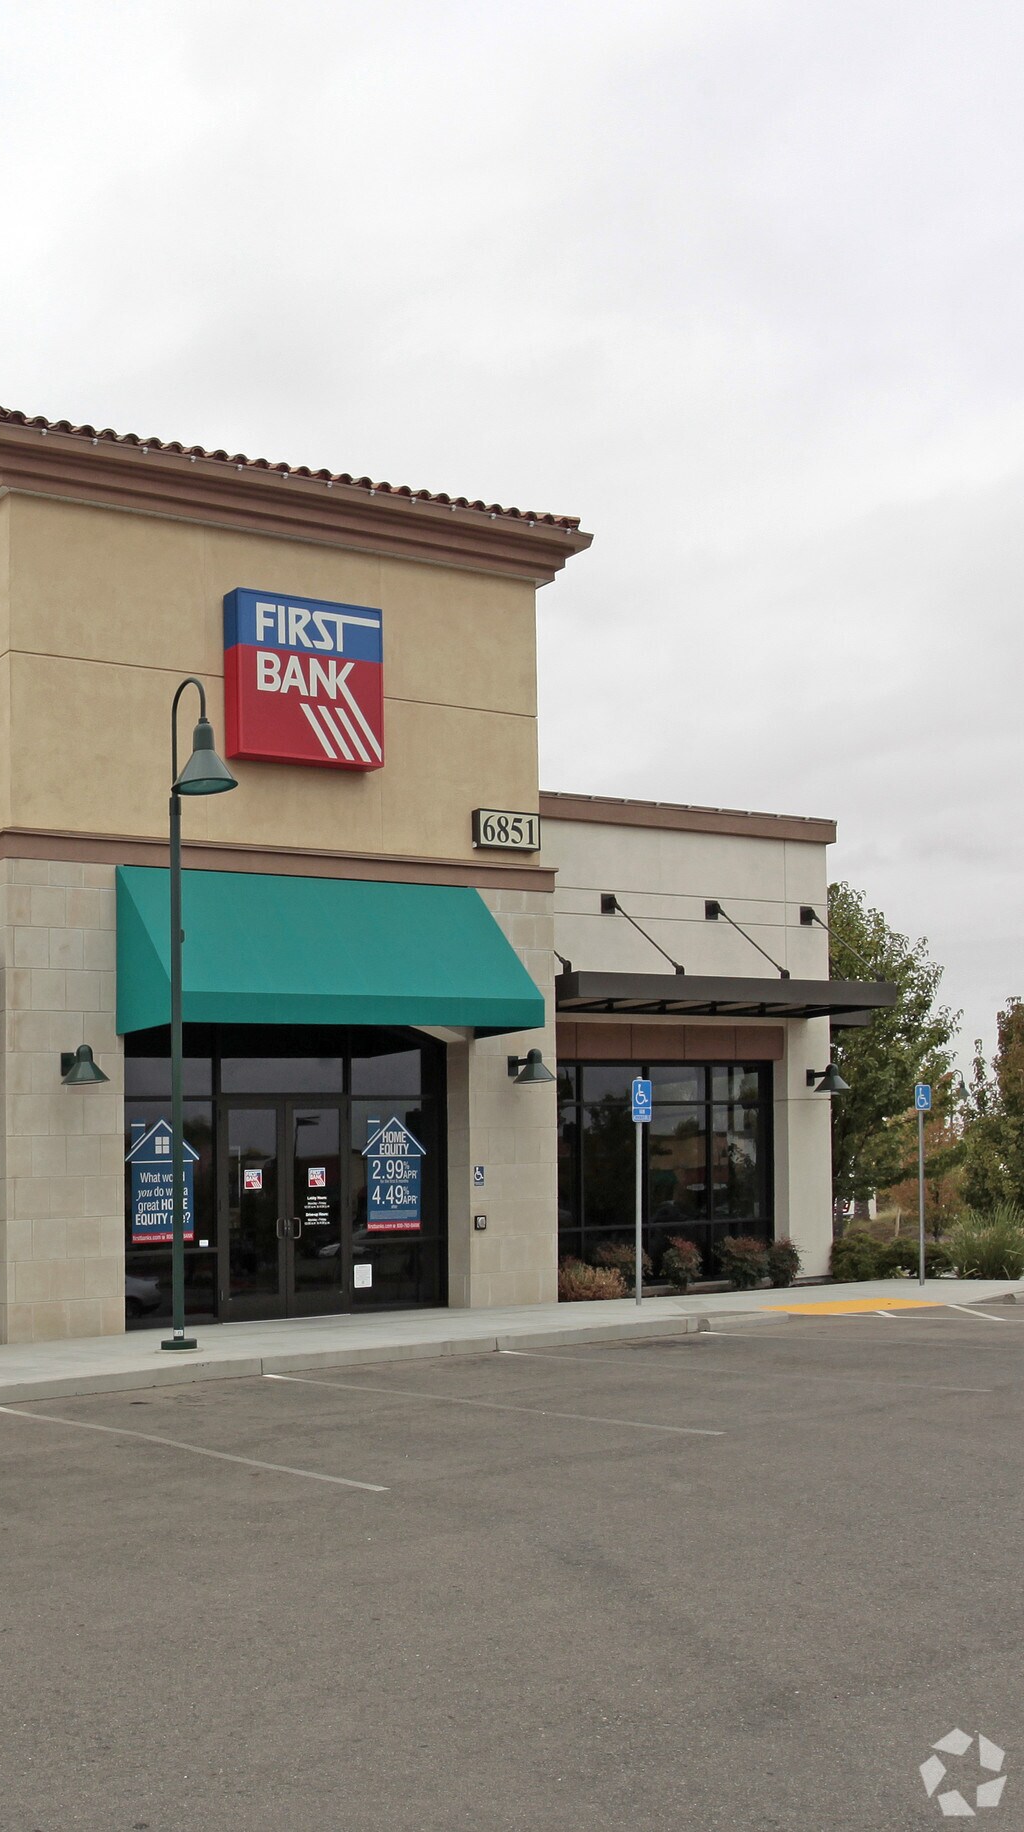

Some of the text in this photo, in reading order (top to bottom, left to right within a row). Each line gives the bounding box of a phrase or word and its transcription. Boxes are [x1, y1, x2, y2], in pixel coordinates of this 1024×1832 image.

[256, 602, 380, 652] FIRST
[483, 814, 536, 846] 6851
[382, 1131, 407, 1143] HOME
[379, 1143, 410, 1155] EQUITY
[140, 1172, 161, 1183] What
[136, 1189, 153, 1201] you
[154, 1186, 164, 1197] do
[183, 1187, 188, 1196] a
[138, 1198, 188, 1214] great HOE
[135, 1213, 168, 1226] EQUITY
